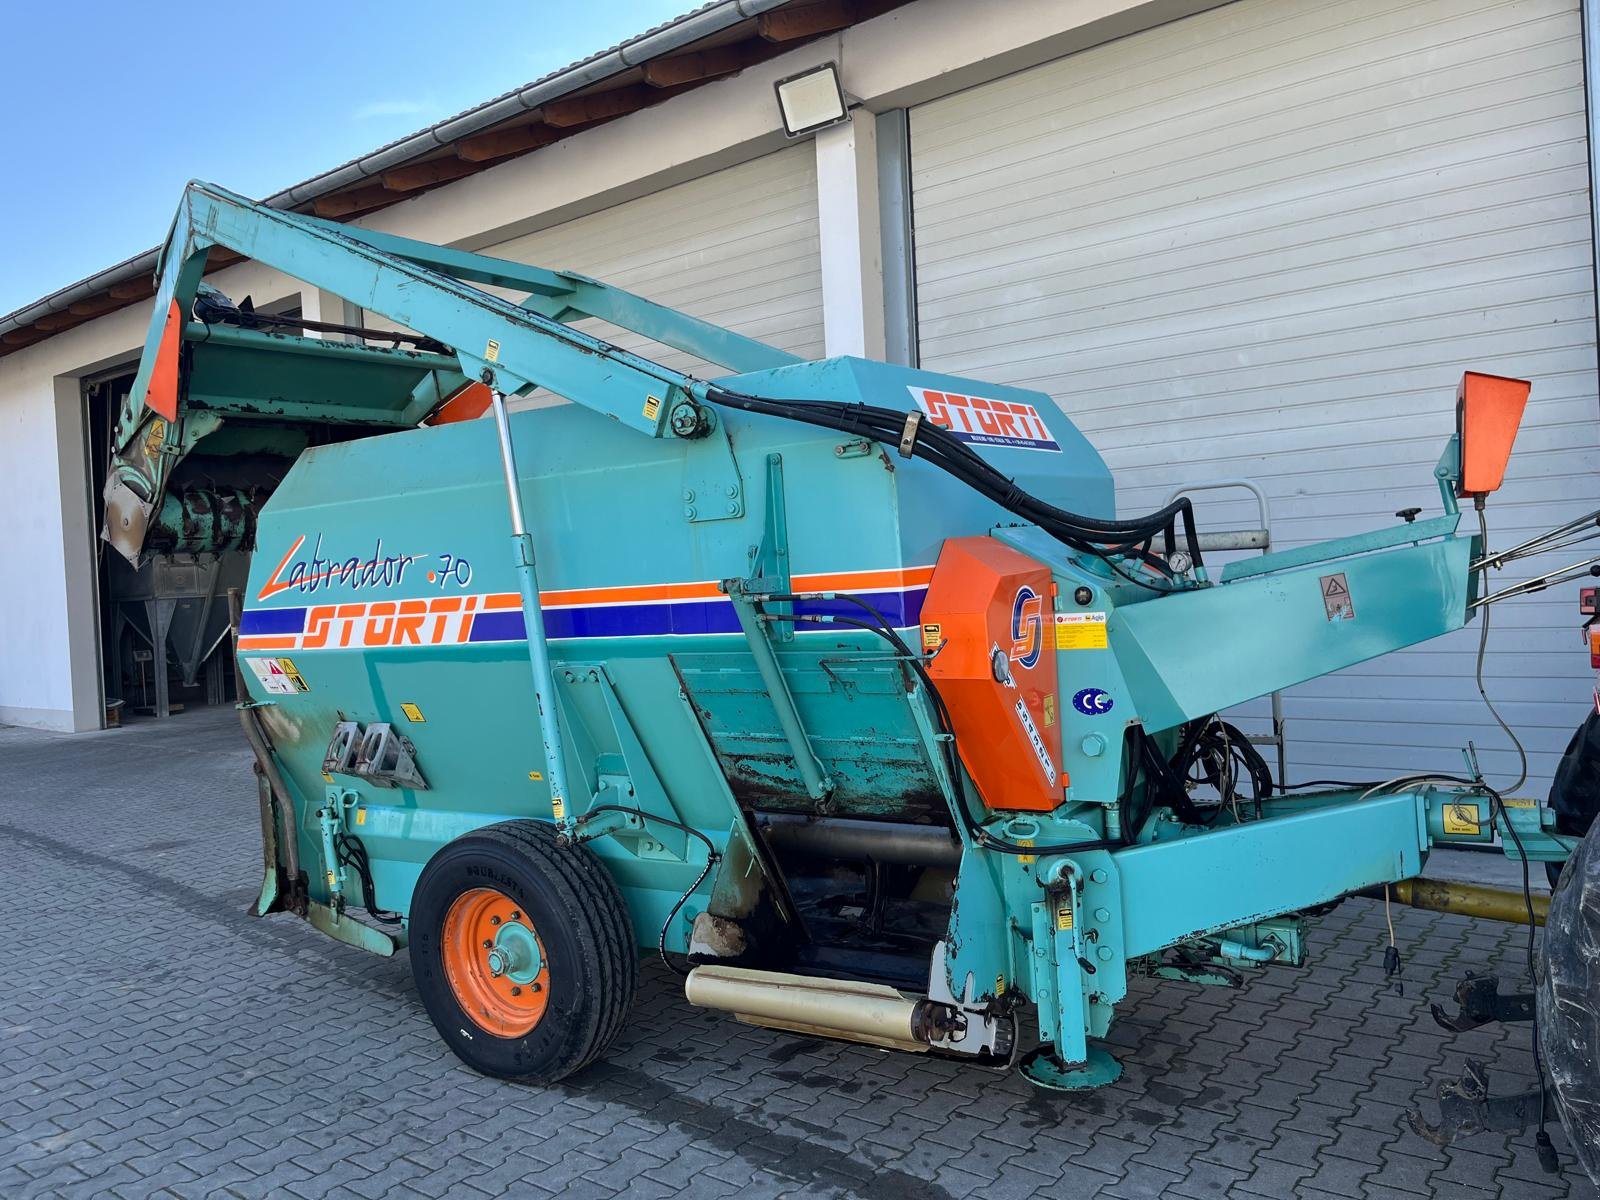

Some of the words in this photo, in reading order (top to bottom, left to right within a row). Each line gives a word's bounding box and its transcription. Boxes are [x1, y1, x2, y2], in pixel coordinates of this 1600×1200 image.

[923, 390, 1048, 440] STORTI
[258, 532, 427, 602] Labrador
[301, 595, 479, 648] STORTI
